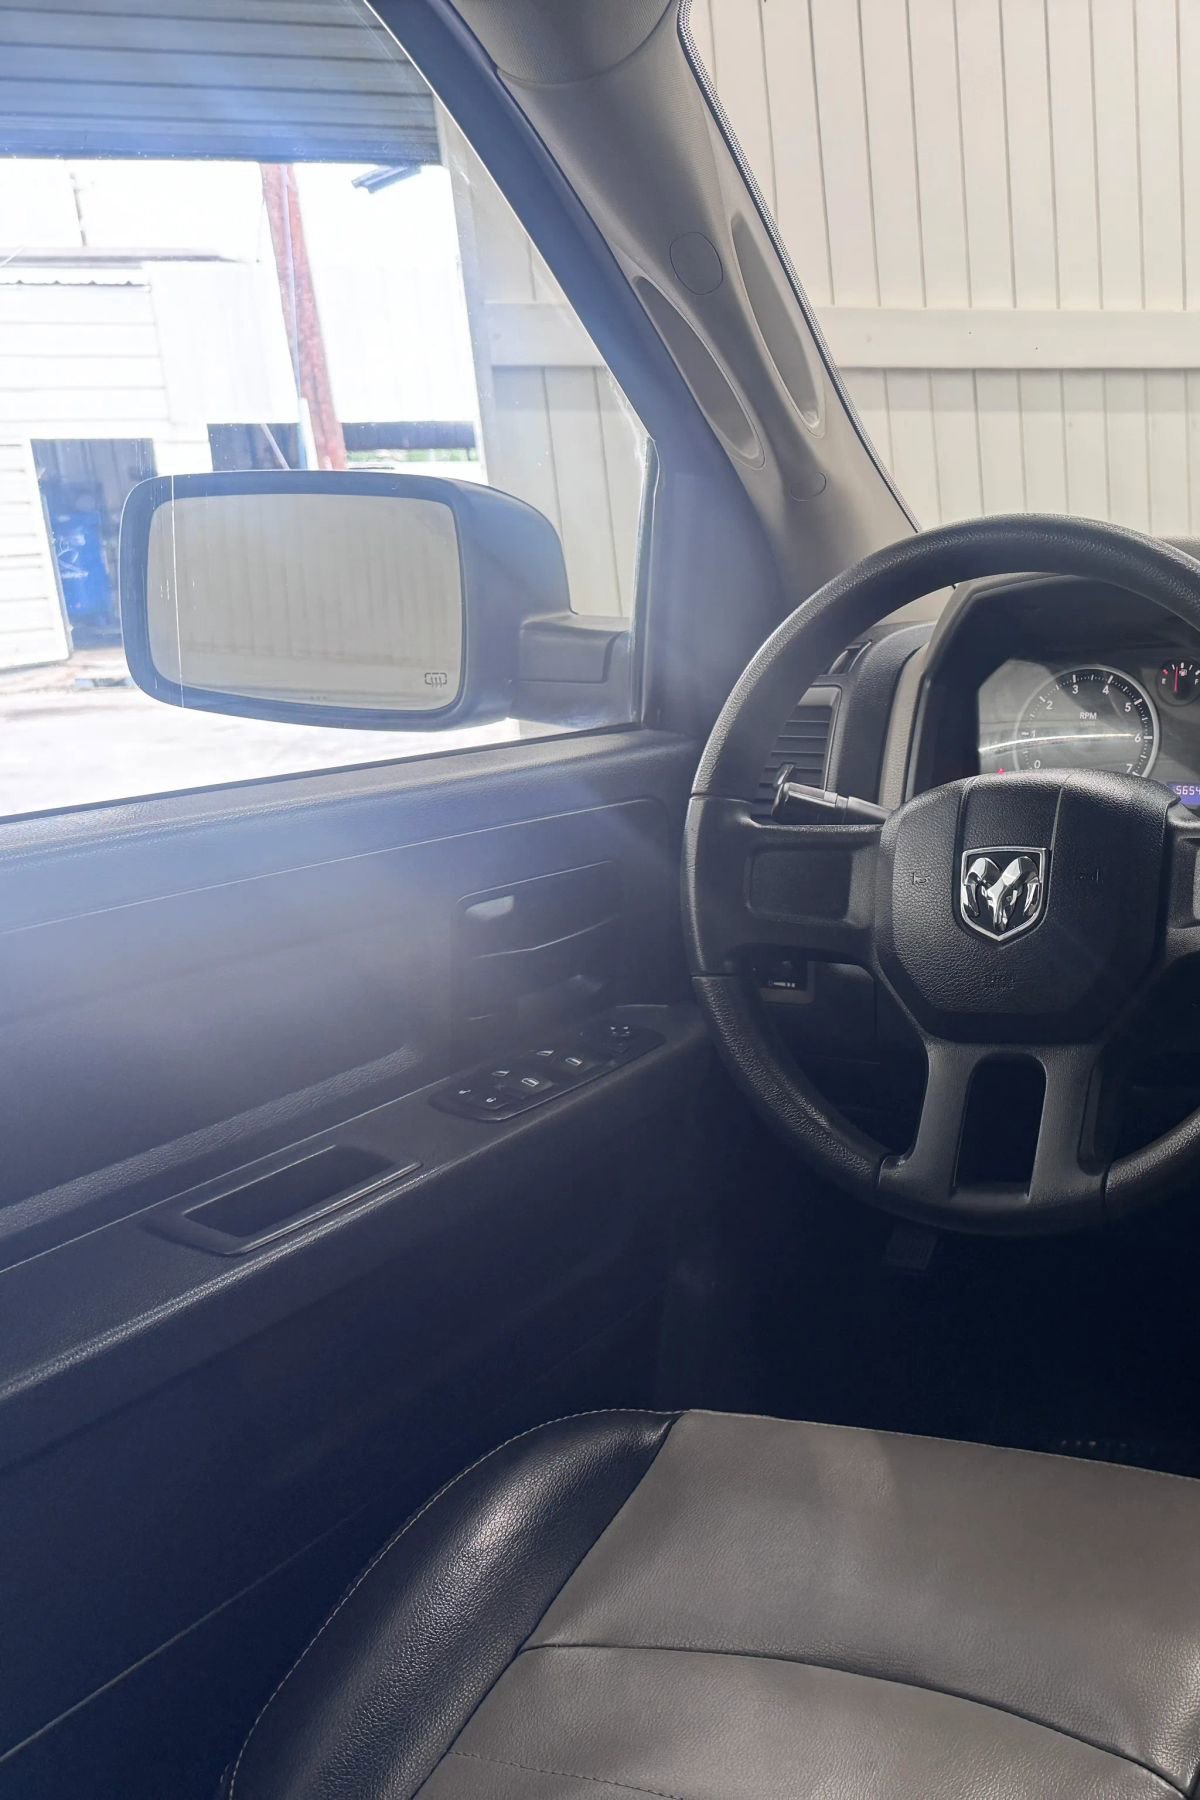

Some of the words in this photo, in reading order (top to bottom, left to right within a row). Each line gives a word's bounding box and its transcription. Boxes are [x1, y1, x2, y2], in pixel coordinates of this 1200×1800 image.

[1072, 684, 1079, 695] 3
[1102, 685, 1109, 695] 4
[1046, 700, 1053, 710] 2
[1124, 702, 1132, 712] 5
[1079, 711, 1097, 720] RPM
[1031, 730, 1036, 738] 1
[1134, 732, 1141, 743] 6
[1034, 760, 1041, 769] 0
[1126, 763, 1133, 773] 7
